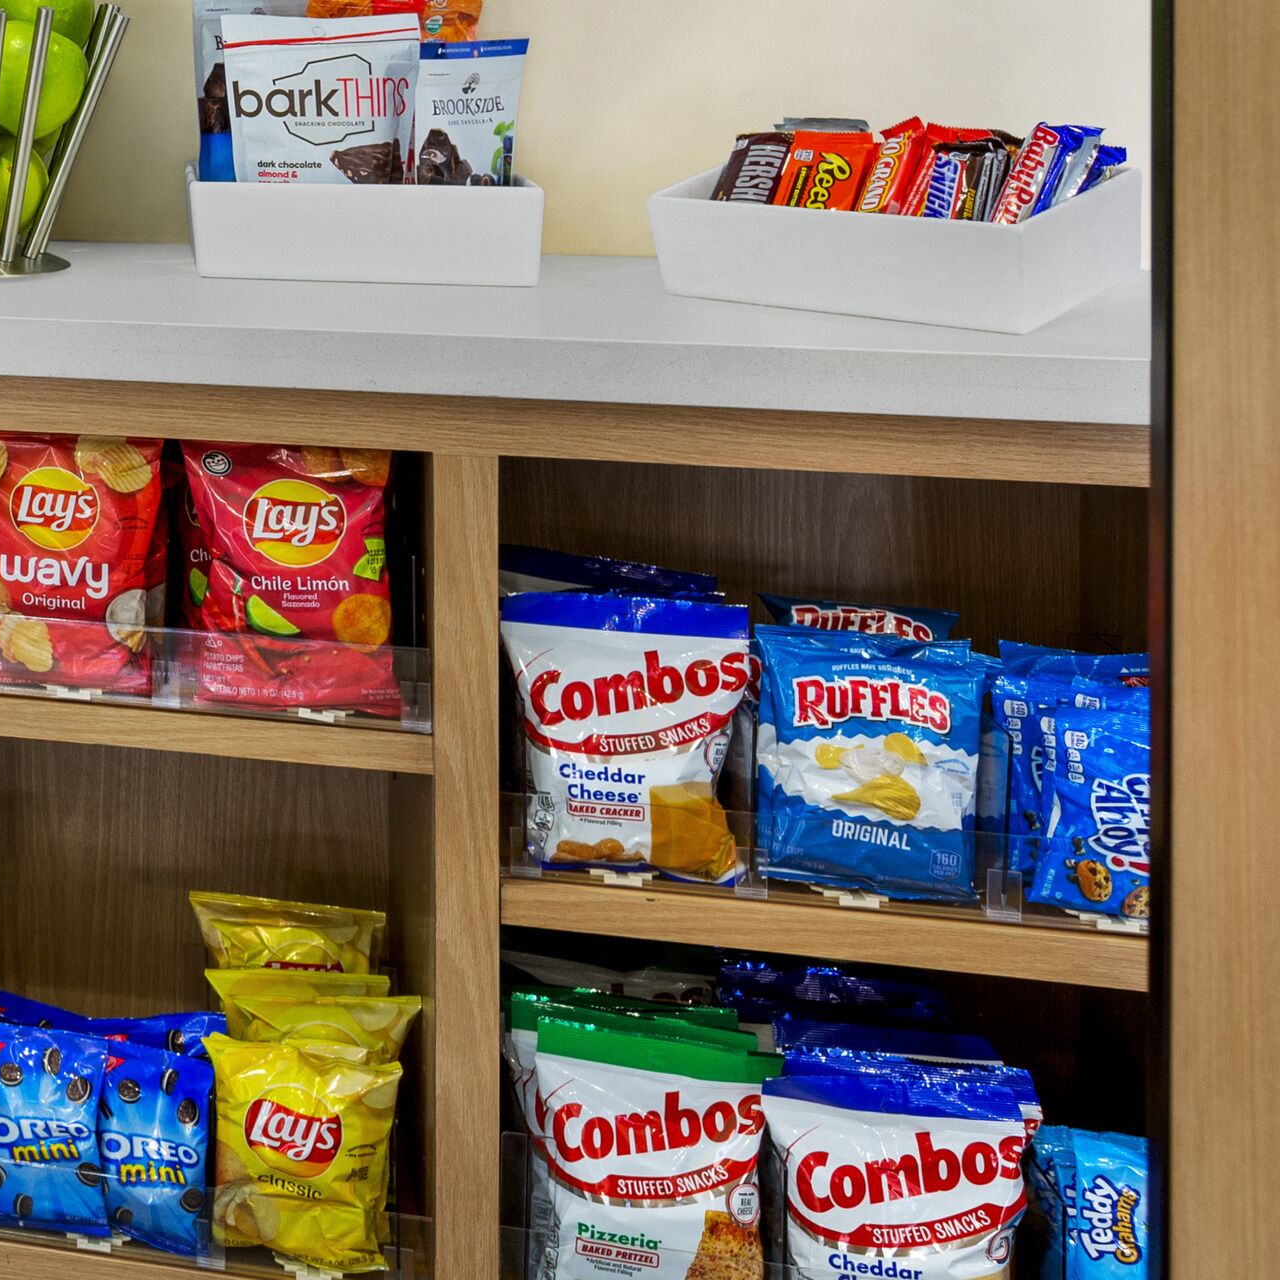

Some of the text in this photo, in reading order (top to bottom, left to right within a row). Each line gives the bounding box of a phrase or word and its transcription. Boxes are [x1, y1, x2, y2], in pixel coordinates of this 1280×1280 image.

[432, 96, 505, 116] BROOKSIDE
[257, 160, 322, 169] dark chocolate
[17, 486, 94, 531] Lay's
[252, 499, 339, 546] Lay's
[251, 576, 350, 591] Chile Limón
[22, 593, 86, 610] Original
[530, 650, 748, 726] Combos
[794, 678, 950, 732] RUFFLES
[600, 718, 711, 752] STUFFED SNACKS
[559, 764, 645, 785] Cheddar
[568, 784, 639, 803] Cheese
[832, 820, 911, 851] ORIGINAL
[250, 1102, 338, 1161] Lay's
[553, 1091, 765, 1163] Combos
[12, 1141, 79, 1162] mini
[617, 1166, 728, 1194] STUFFED SNACKS
[796, 1132, 1023, 1213] Combos
[1080, 1175, 1119, 1262] Teddy
[1114, 1188, 1140, 1265] Grahams
[577, 1223, 659, 1250] Pizzeria
